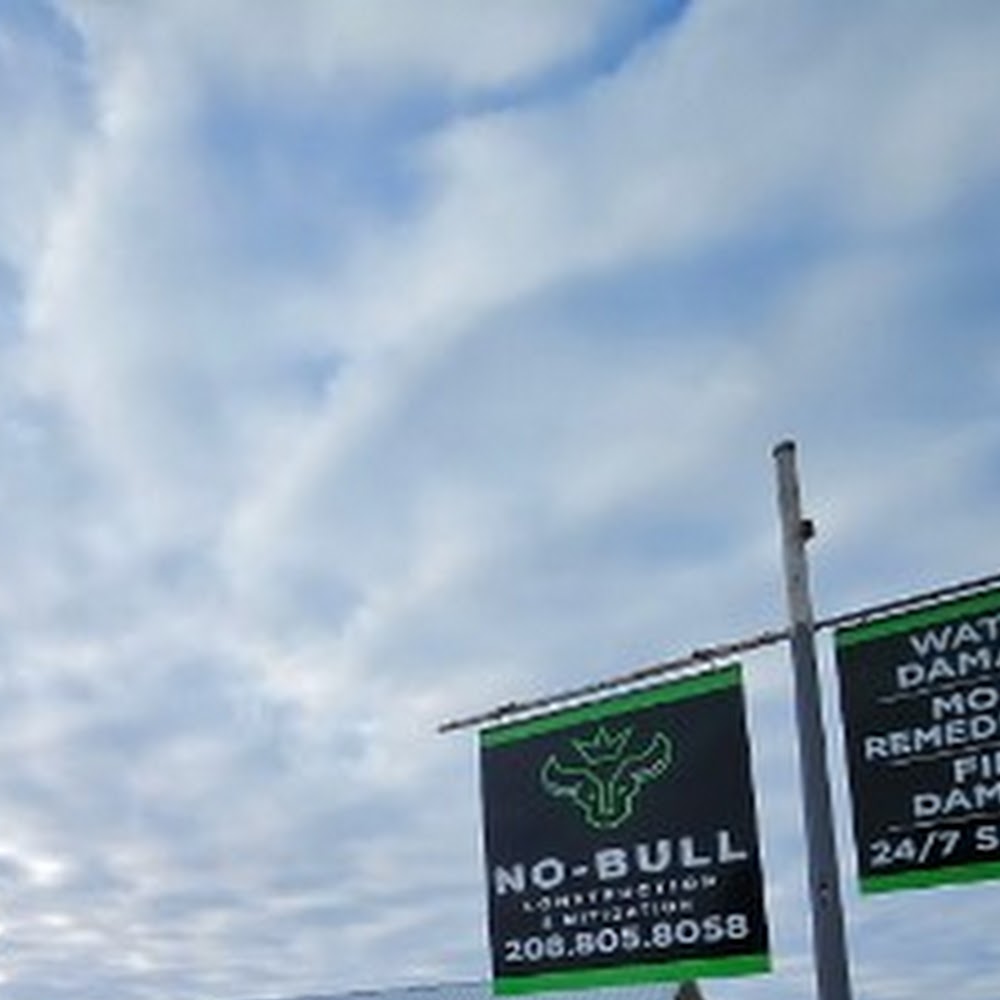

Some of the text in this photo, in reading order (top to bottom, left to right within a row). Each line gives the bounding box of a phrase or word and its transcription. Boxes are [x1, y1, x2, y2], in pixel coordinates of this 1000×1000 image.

[896, 646, 1000, 689] DAM
[932, 686, 998, 720] MO
[912, 781, 1000, 818] DAM
[493, 829, 748, 896] NO-BULL
[869, 829, 961, 868] 24/7
